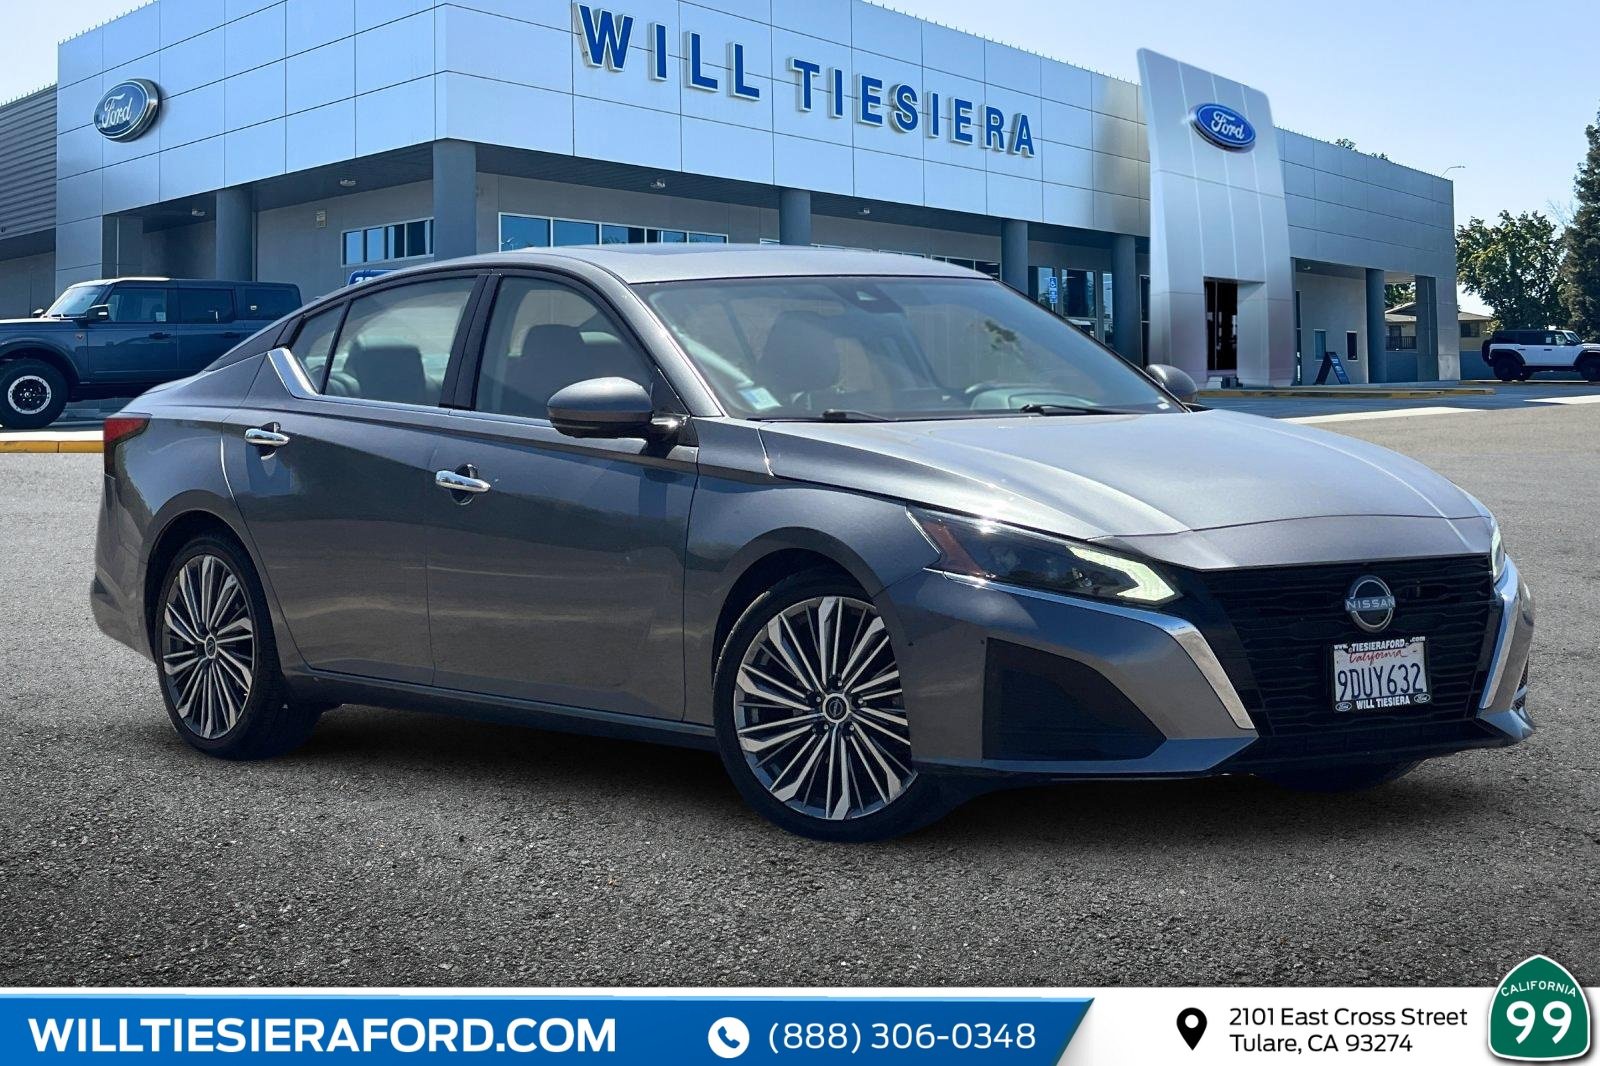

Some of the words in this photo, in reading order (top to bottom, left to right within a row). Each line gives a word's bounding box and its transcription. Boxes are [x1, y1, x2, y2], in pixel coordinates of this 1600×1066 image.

[576, 3, 760, 100] WILL
[788, 57, 1035, 157] TIESIERA
[101, 93, 133, 128] Ford
[1211, 111, 1245, 139] Ford
[1346, 597, 1395, 610] NISSAN
[1352, 638, 1405, 652] TIESIERAFORD
[1349, 649, 1407, 666] California
[1337, 662, 1424, 701] 9DUY632
[1356, 699, 1375, 710] WILL
[1375, 695, 1411, 708] TIESIERA
